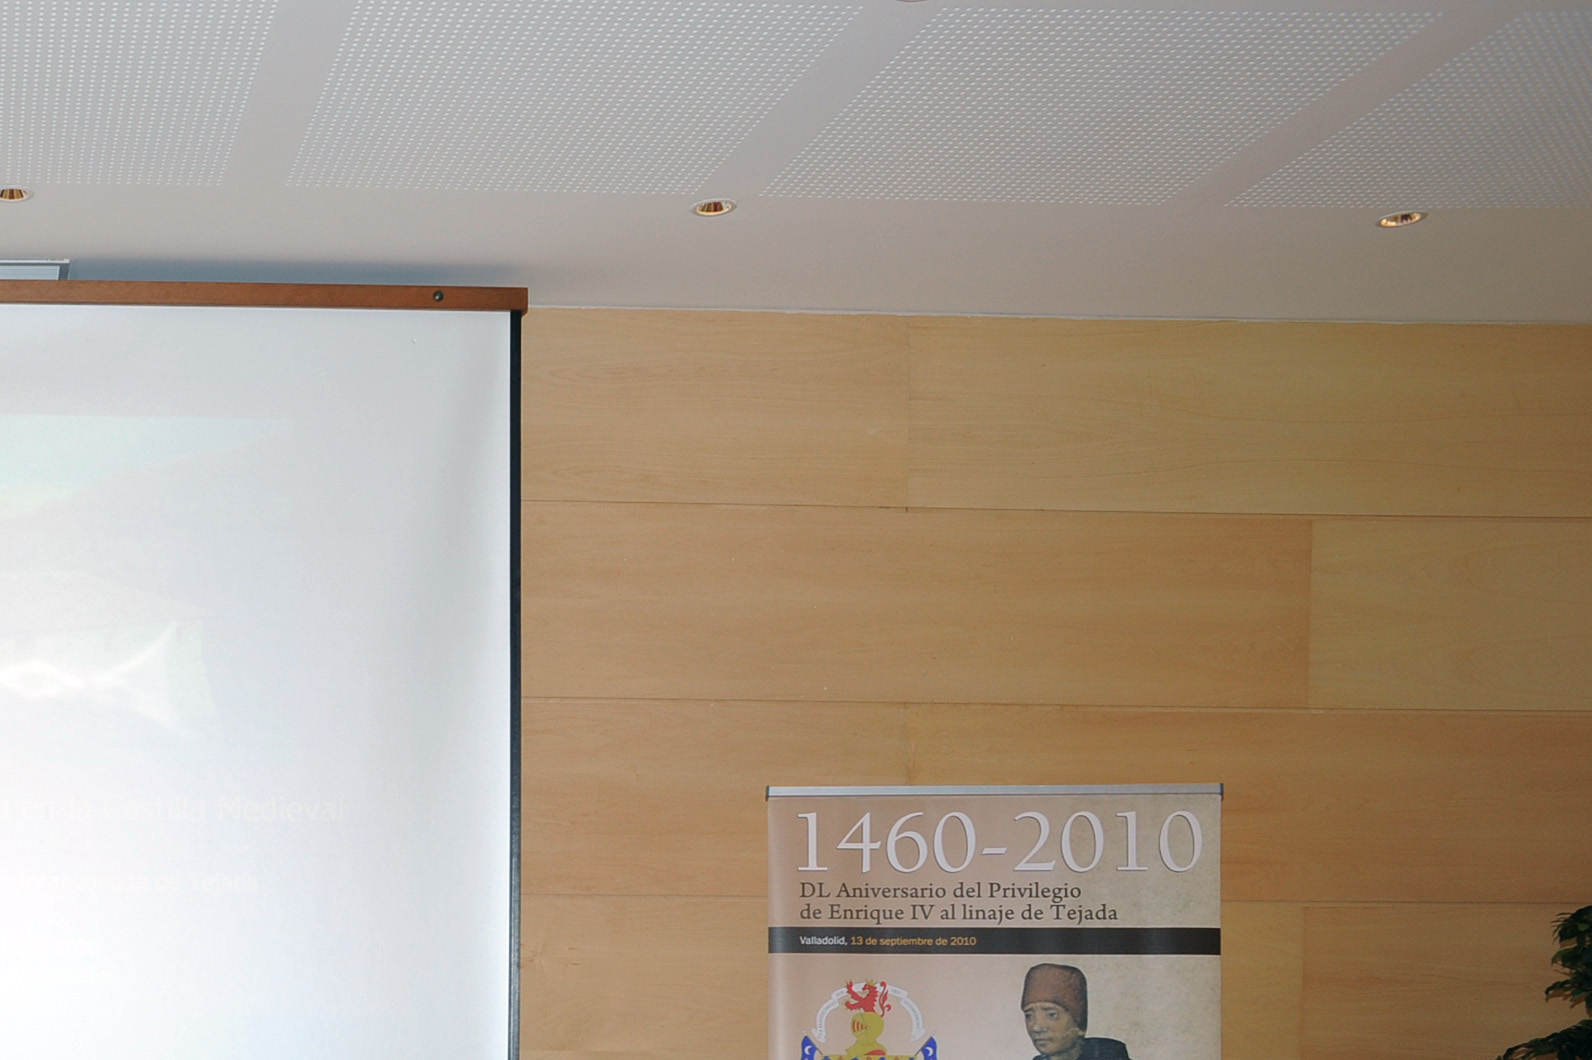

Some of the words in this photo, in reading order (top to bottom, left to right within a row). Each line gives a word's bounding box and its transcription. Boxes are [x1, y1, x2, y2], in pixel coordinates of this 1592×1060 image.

[216, 795, 345, 822] Medieval
[797, 811, 1204, 875] 1460-2010
[799, 882, 831, 898] DL
[836, 882, 946, 898] Aniversario
[953, 881, 983, 898] del
[988, 881, 1082, 904] Privilegio
[799, 903, 823, 920] de
[828, 904, 904, 925] Enrique
[911, 904, 935, 920] IV
[940, 903, 956, 920] al
[962, 902, 1015, 925] linaje
[1021, 903, 1045, 920] de
[1050, 903, 1118, 922] Tejada
[799, 936, 848, 946] Valladolid,
[850, 937, 864, 946] 13
[865, 936, 878, 946] de
[880, 936, 933, 948] septiembre
[935, 936, 948, 946] de
[950, 937, 977, 946] 2010
